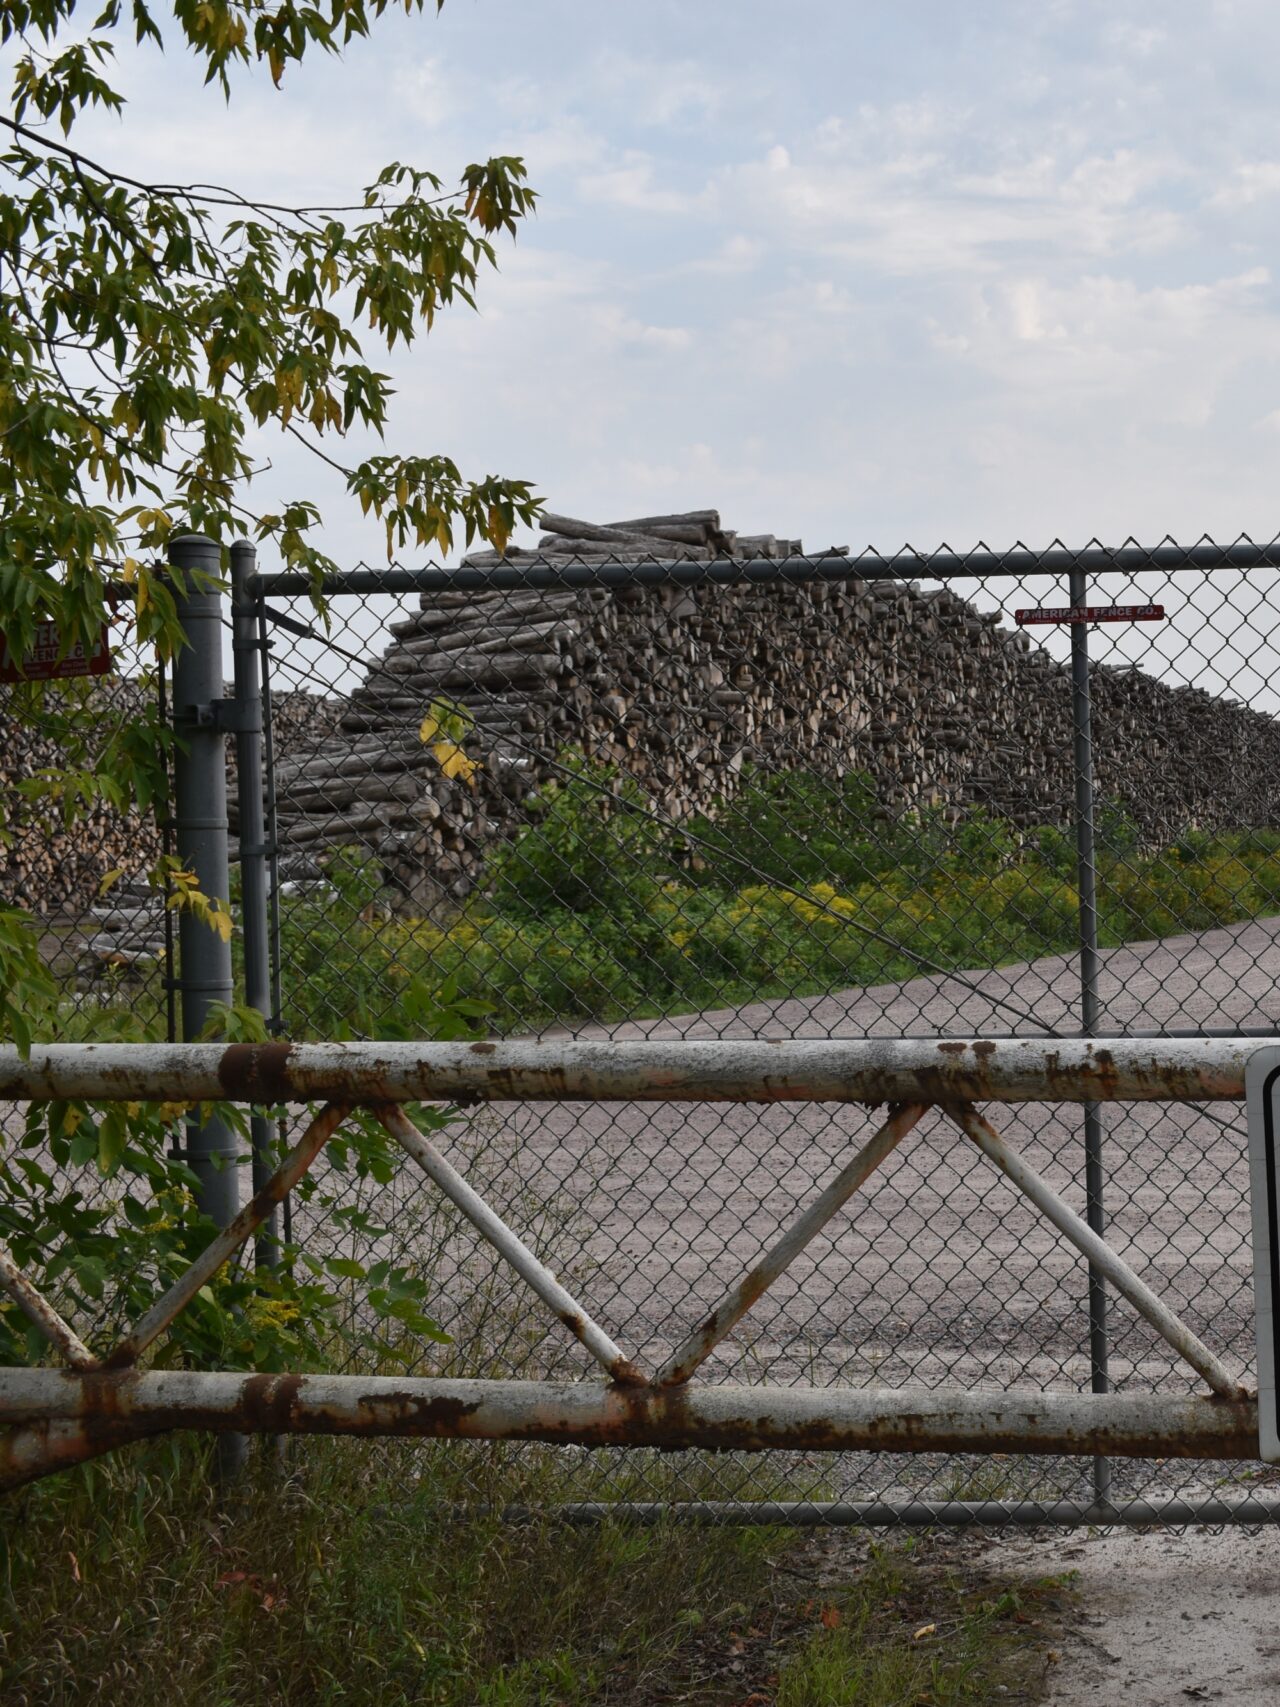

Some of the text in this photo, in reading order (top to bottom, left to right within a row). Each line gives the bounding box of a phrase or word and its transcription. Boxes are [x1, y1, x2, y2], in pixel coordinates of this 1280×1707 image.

[1022, 606, 1158, 619] AMERICAN FENCE CO.
